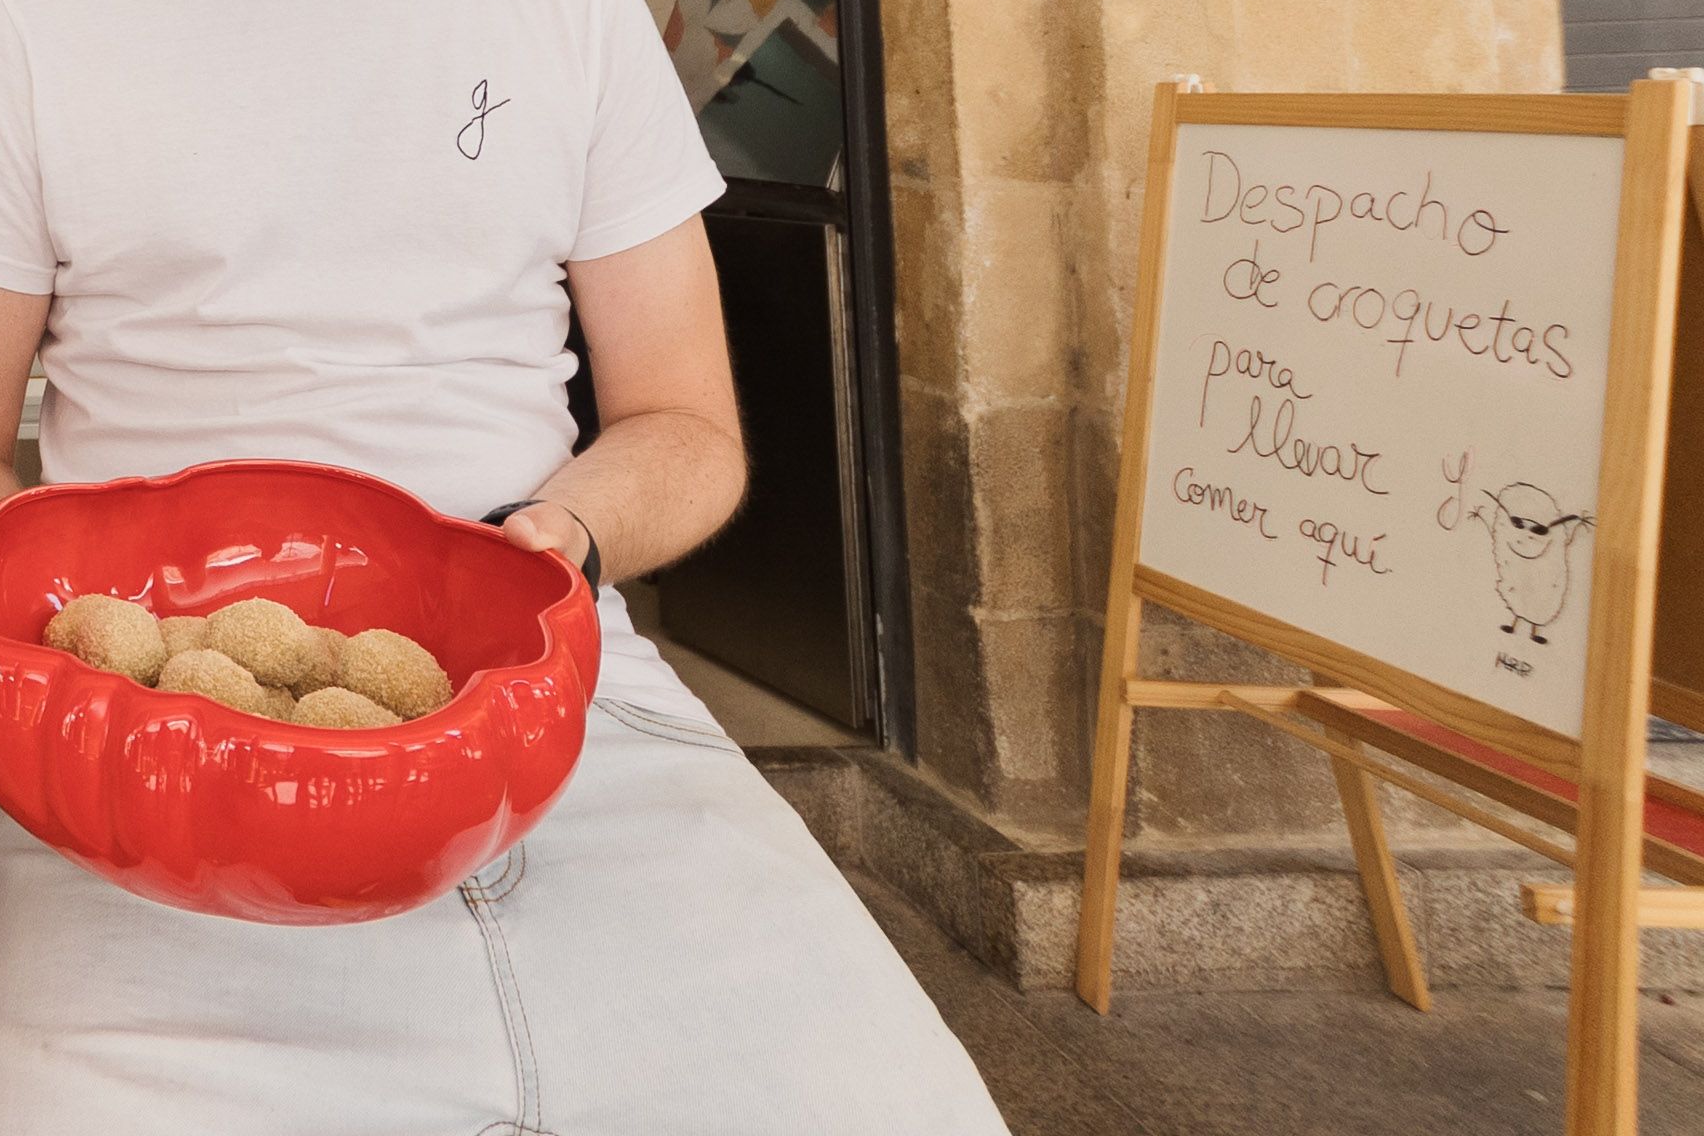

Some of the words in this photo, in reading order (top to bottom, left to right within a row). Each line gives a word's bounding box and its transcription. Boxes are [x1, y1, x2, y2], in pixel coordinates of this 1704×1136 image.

[1200, 150, 1510, 263] Despacho
[1223, 239, 1281, 307] de
[1307, 282, 1573, 378] croquetas
[1199, 340, 1313, 428] para
[1226, 395, 1390, 495] llevar
[1298, 518, 1394, 587] aquí
